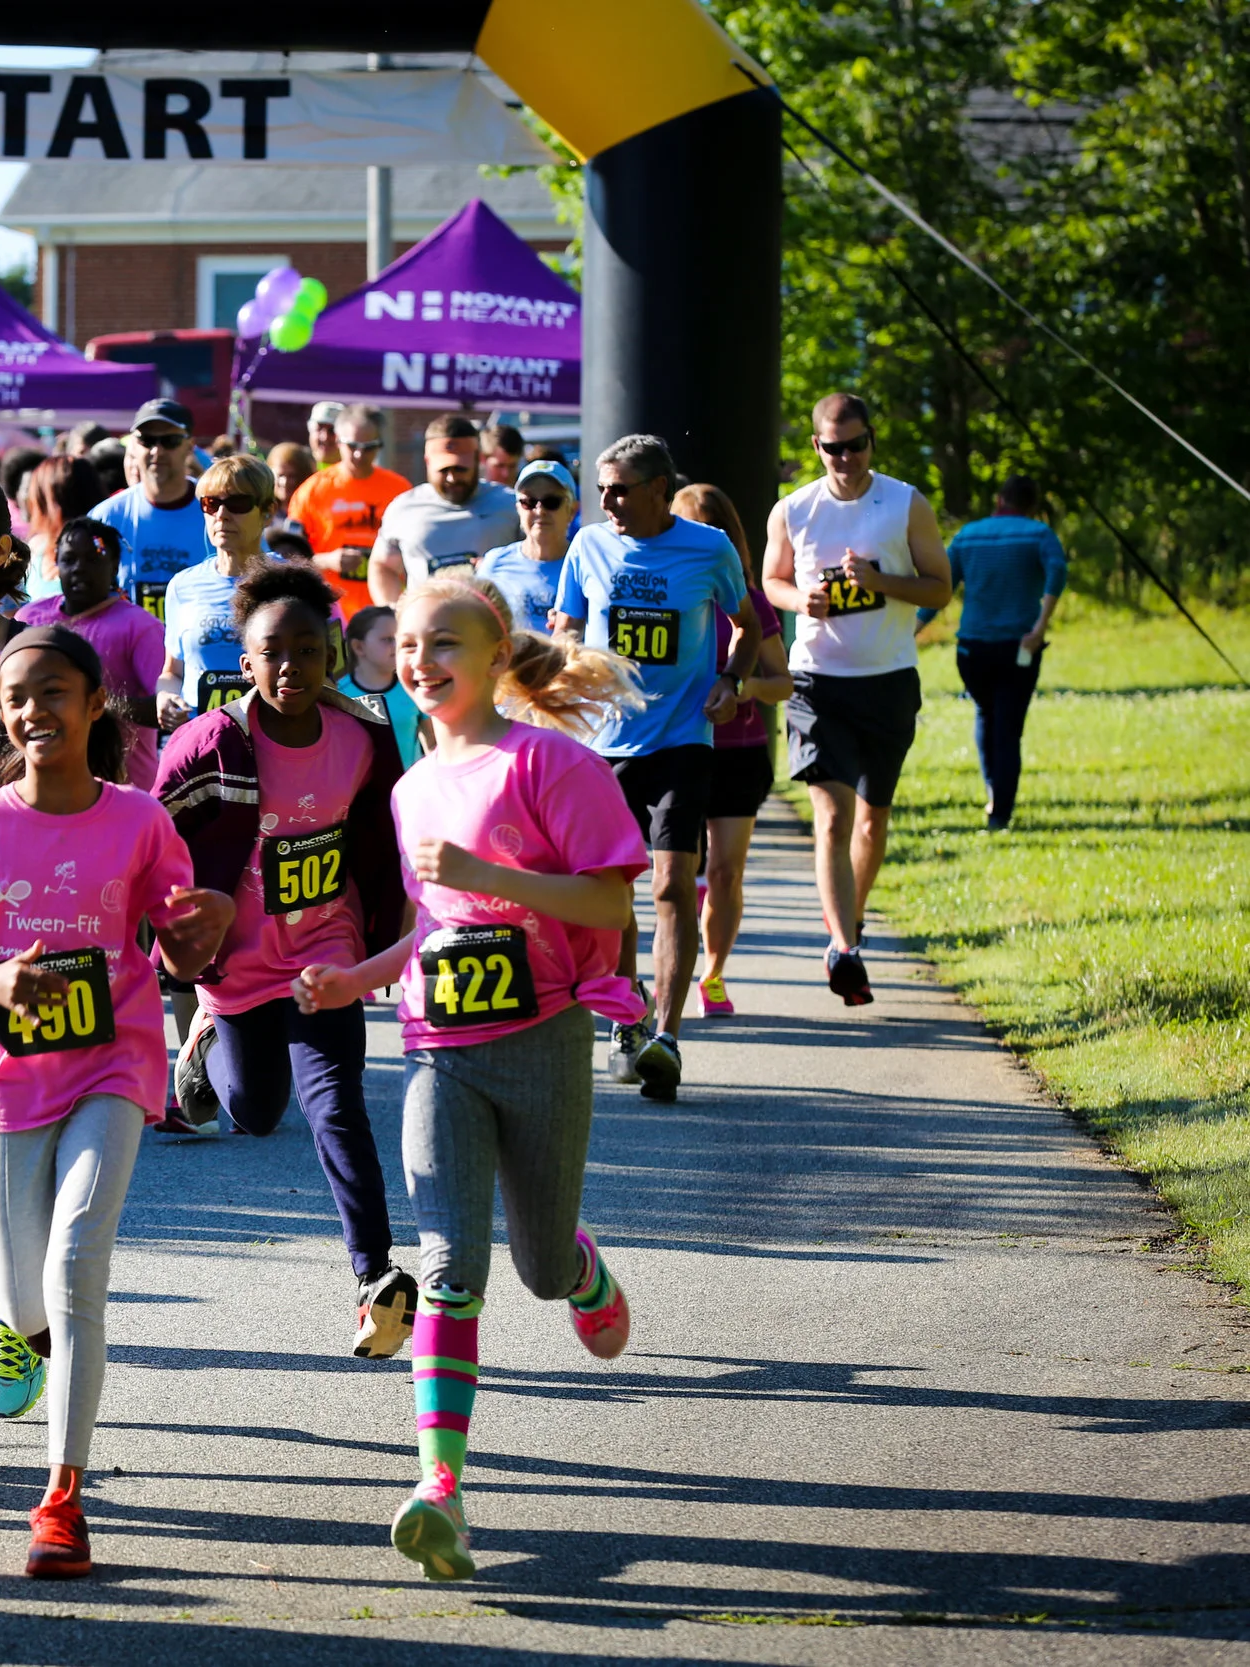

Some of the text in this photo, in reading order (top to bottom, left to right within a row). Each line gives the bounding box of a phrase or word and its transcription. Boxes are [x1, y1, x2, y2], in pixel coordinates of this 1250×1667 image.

[450, 291, 578, 318] NOVANT
[450, 306, 566, 329] HEALTH
[454, 353, 562, 378] NOVANT
[453, 373, 553, 398] HEALTH
[616, 623, 668, 659] 510
[292, 832, 333, 848] JUNCTION
[278, 849, 341, 904] 502
[5, 911, 101, 934] Tween-Fit
[494, 929, 511, 938] 311
[77, 954, 93, 964] 311
[434, 953, 520, 1015] 422
[7, 979, 96, 1044] 490
